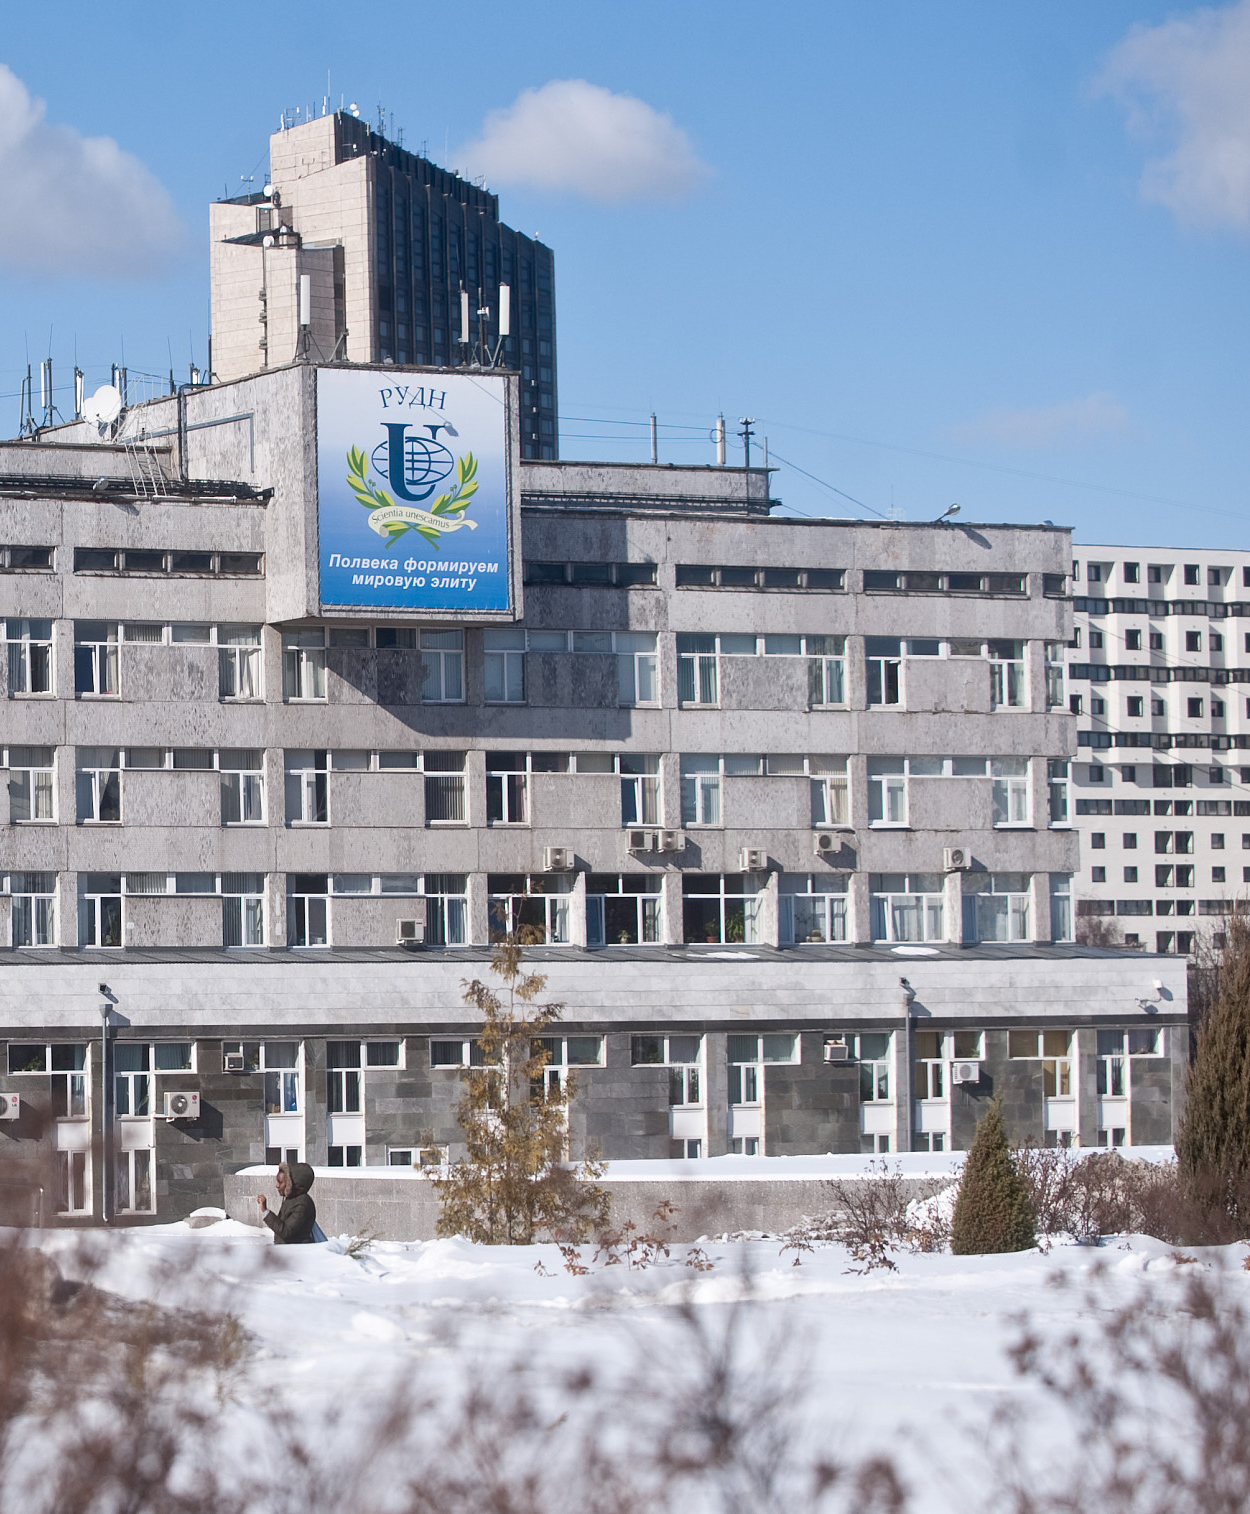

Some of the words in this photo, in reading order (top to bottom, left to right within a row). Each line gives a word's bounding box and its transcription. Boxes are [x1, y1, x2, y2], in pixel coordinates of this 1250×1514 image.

[378, 385, 448, 411] РУДН
[371, 507, 404, 525] Scientia
[405, 510, 450, 529] unescamus
[328, 553, 399, 570] Полвека
[403, 557, 499, 575] формируем
[351, 573, 426, 590] мировую
[430, 576, 477, 592] элиту
